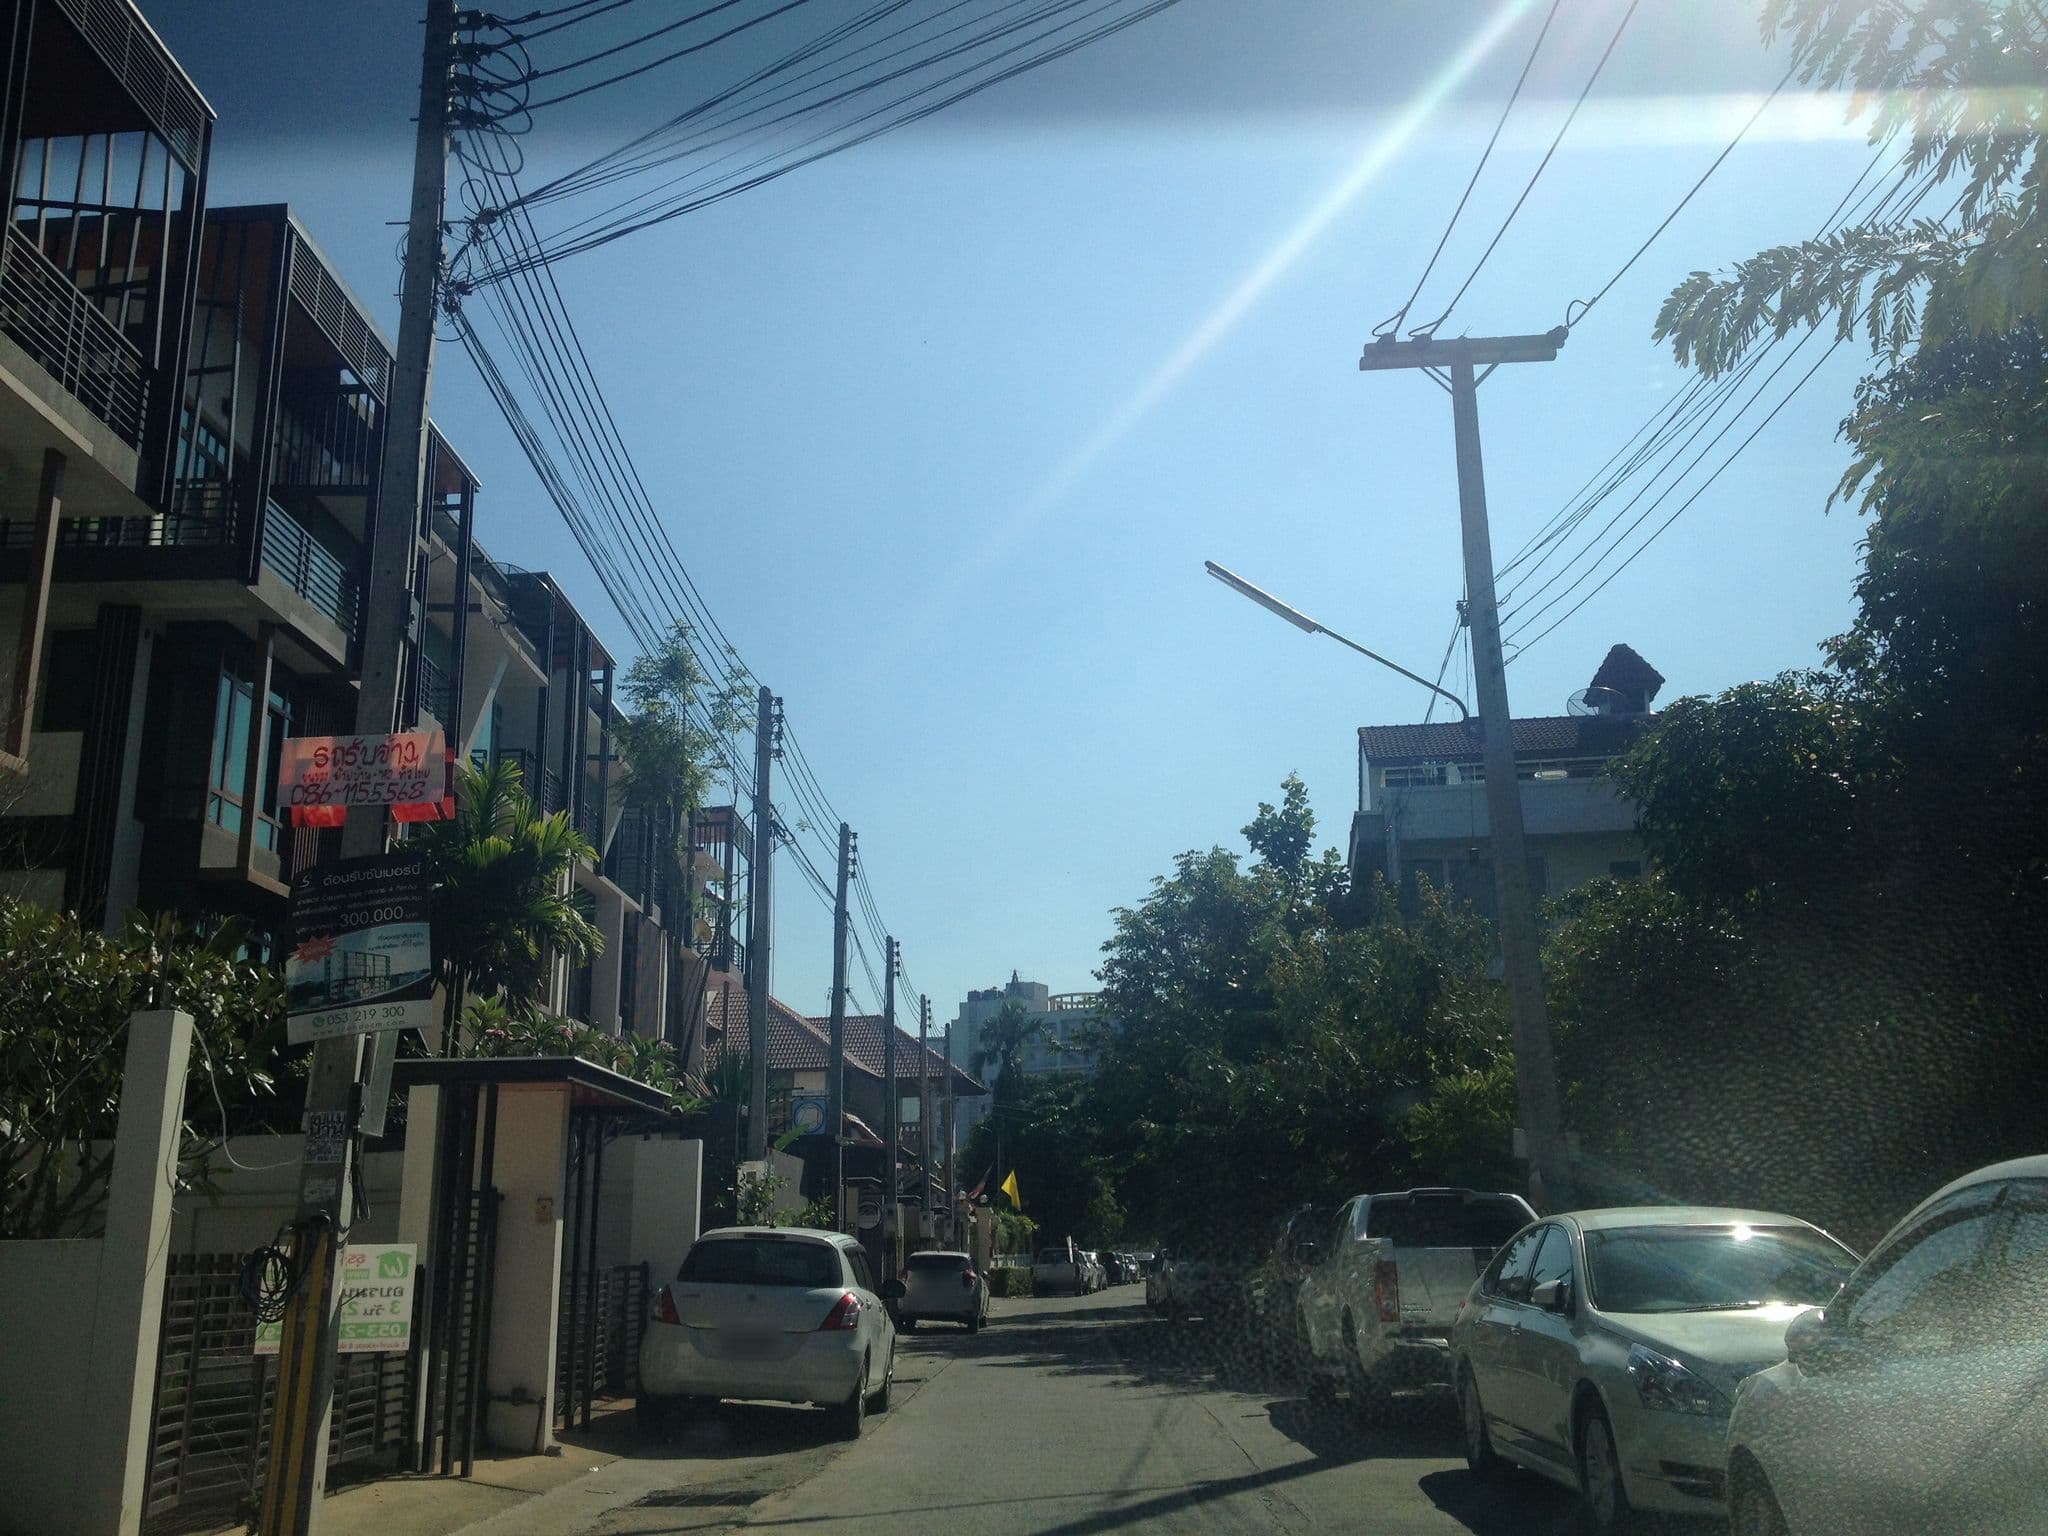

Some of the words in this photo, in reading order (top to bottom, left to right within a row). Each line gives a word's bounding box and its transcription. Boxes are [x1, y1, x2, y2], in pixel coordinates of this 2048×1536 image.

[312, 738, 420, 768] รถรับจ้าง
[290, 781, 426, 805] 086-1155568
[327, 1012, 349, 1025] 053
[354, 1008, 377, 1022] 219
[382, 1005, 405, 1018] 300
